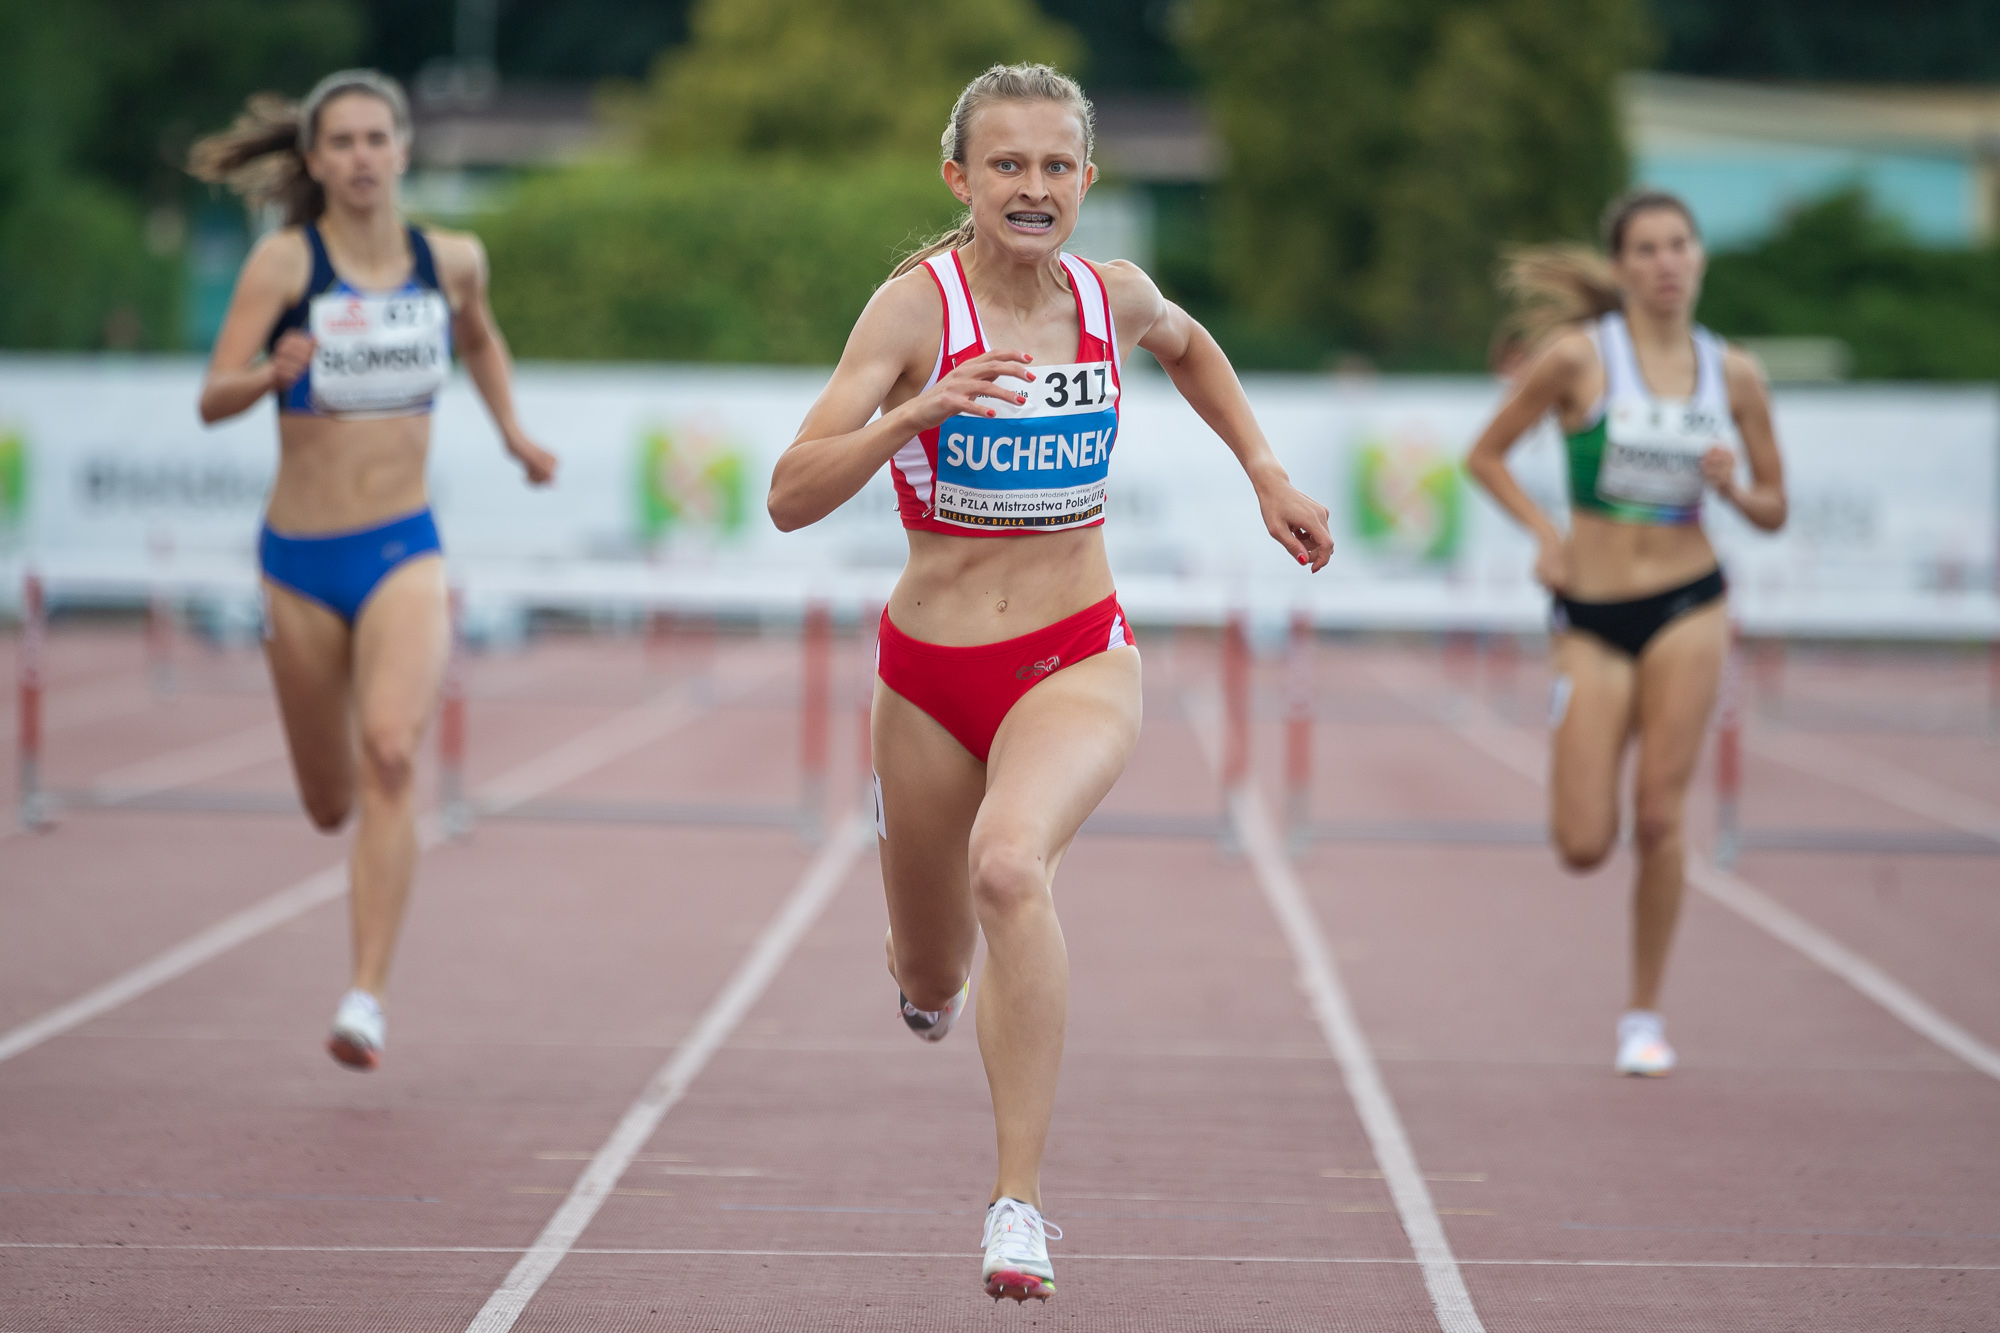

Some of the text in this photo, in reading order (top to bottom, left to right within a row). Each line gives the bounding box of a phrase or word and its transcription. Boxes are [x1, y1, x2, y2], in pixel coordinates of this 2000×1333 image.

[1044, 368, 1107, 408] 317
[946, 427, 1113, 472] SUCHENEK
[939, 493, 956, 506] 54.
[960, 497, 989, 511] PZLA
[992, 500, 1063, 512] Mistrzostwa
[1091, 488, 1105, 502] U18
[958, 489, 1004, 499] Ogólnopolska
[942, 510, 1025, 526] BIELSKO-BIAŁA
